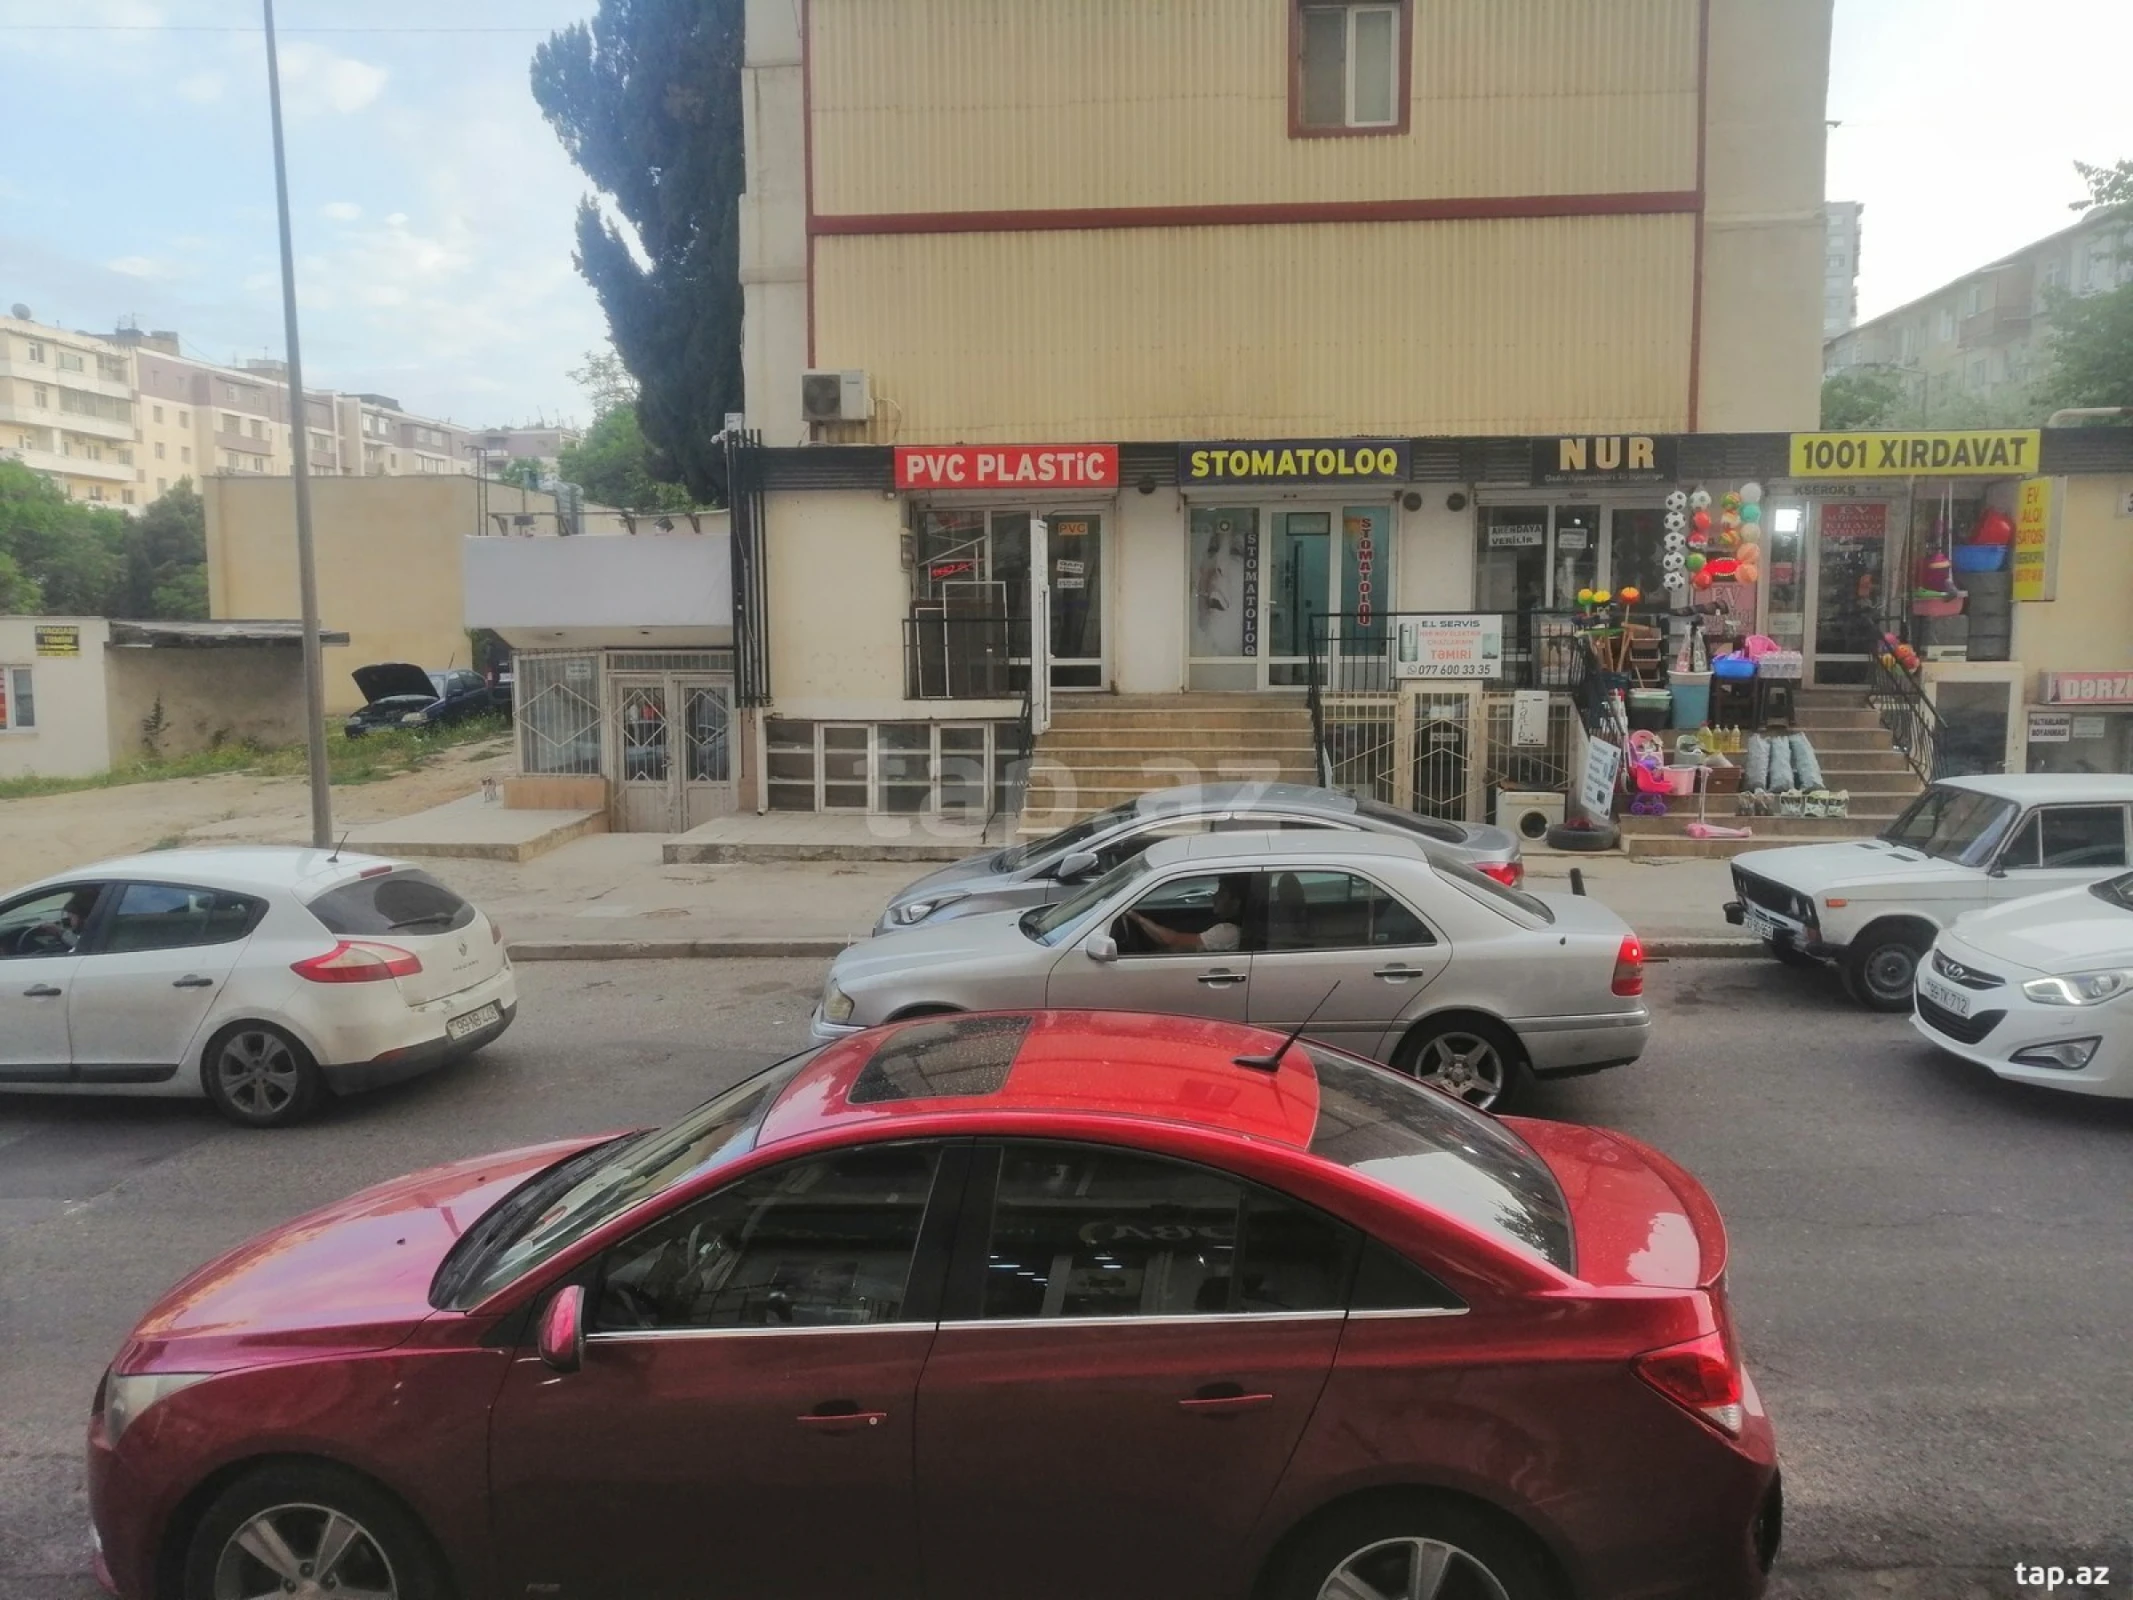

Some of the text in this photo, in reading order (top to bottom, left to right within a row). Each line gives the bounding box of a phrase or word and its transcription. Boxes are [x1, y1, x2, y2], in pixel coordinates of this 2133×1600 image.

[907, 454, 966, 482] PVC
[1191, 448, 1398, 477] STOMATOLOQ
[1560, 437, 1655, 470] NUR
[1803, 438, 2028, 469] 1001 XIRDAVAT
[1059, 523, 1086, 533] PVC
[1244, 534, 1258, 655] STOMATOLOQ
[1418, 664, 1491, 675] 077 600 33 35
